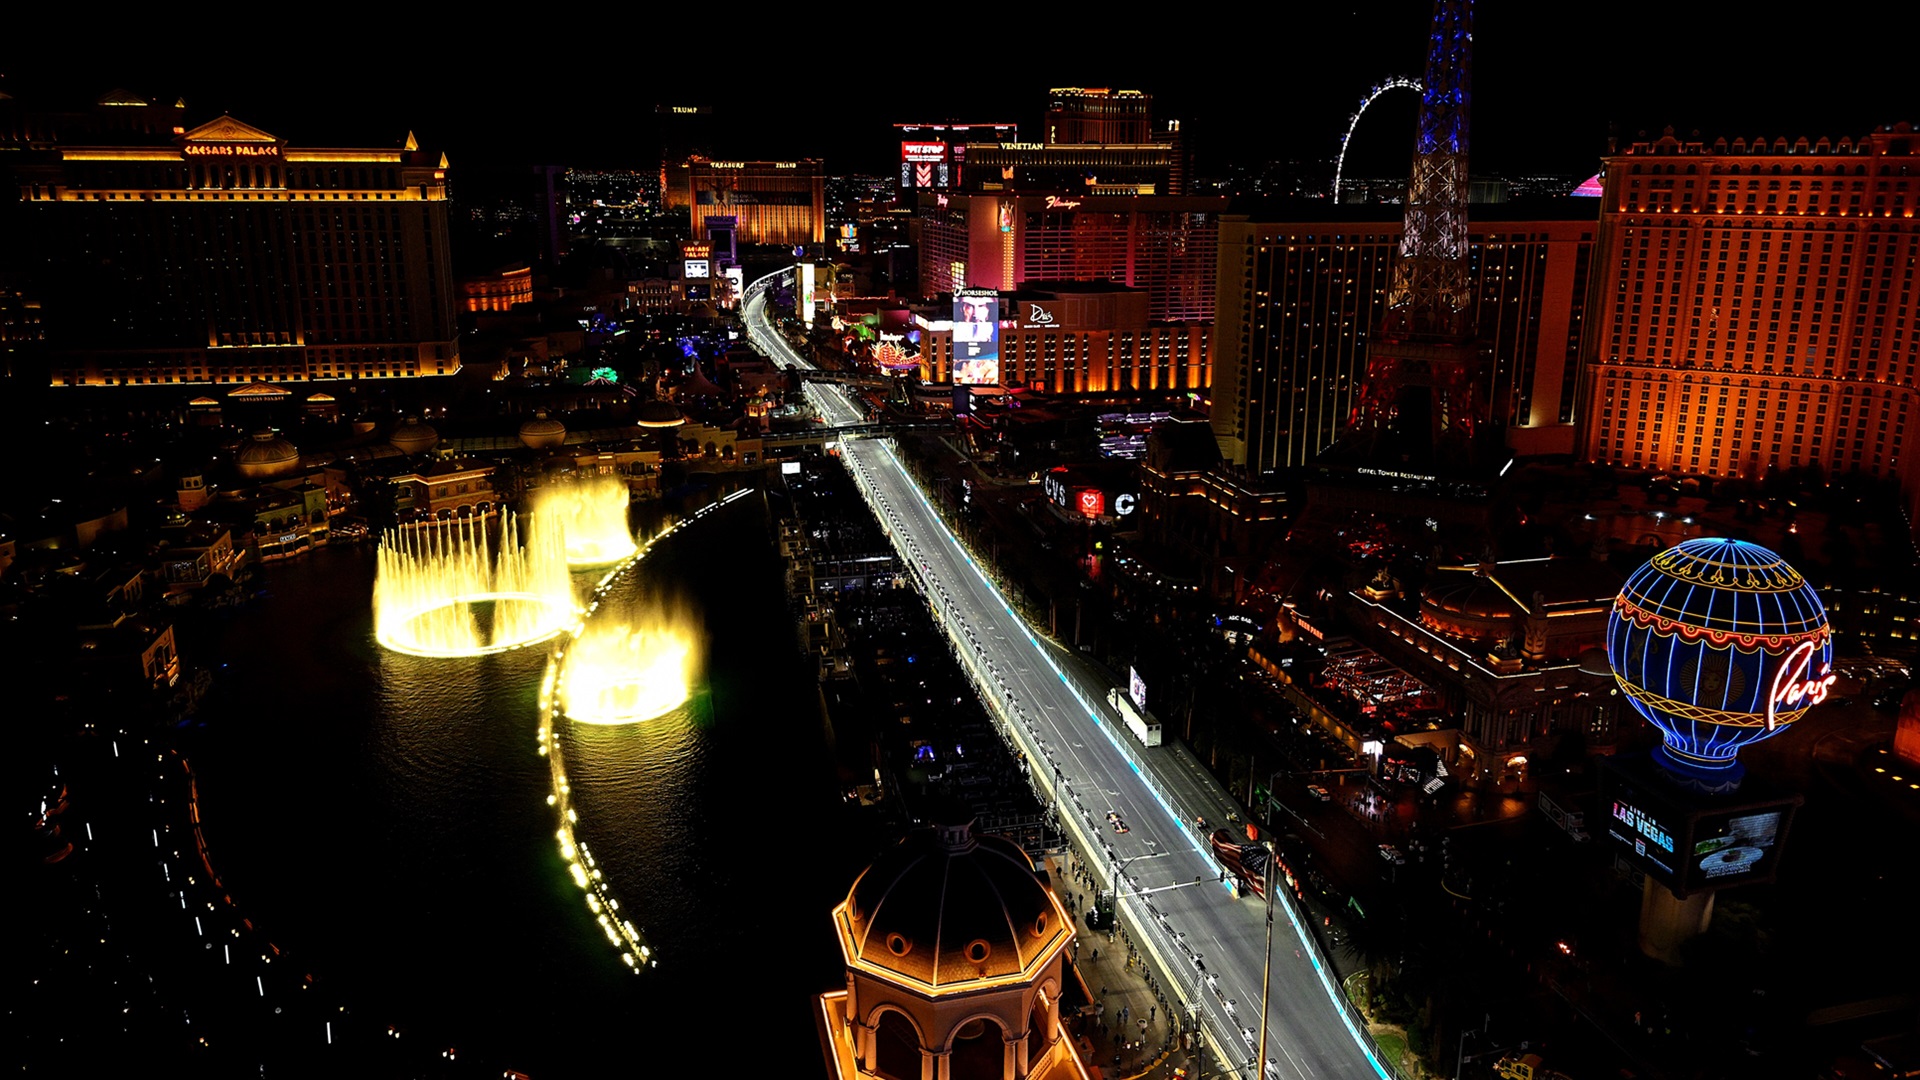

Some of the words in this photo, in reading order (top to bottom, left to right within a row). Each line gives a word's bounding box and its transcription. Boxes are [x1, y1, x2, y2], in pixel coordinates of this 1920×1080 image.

[672, 106, 698, 114] TRUMP
[184, 145, 233, 155] CAESARS
[236, 146, 278, 156] PALACE
[1000, 142, 1044, 150] VENETIAN
[710, 161, 745, 169] TREASURE
[1045, 195, 1081, 210] Flamingo
[961, 289, 999, 297] HORSESHOE
[1377, 469, 1399, 478] TOWER
[1399, 472, 1436, 482] RESTAURANT
[1045, 474, 1066, 507] CVS
[1768, 640, 1837, 732] Paris
[1629, 805, 1646, 820] LIVE
[1648, 816, 1657, 826] IN
[1612, 801, 1635, 828] LAS
[1635, 815, 1674, 854] VEGAS
